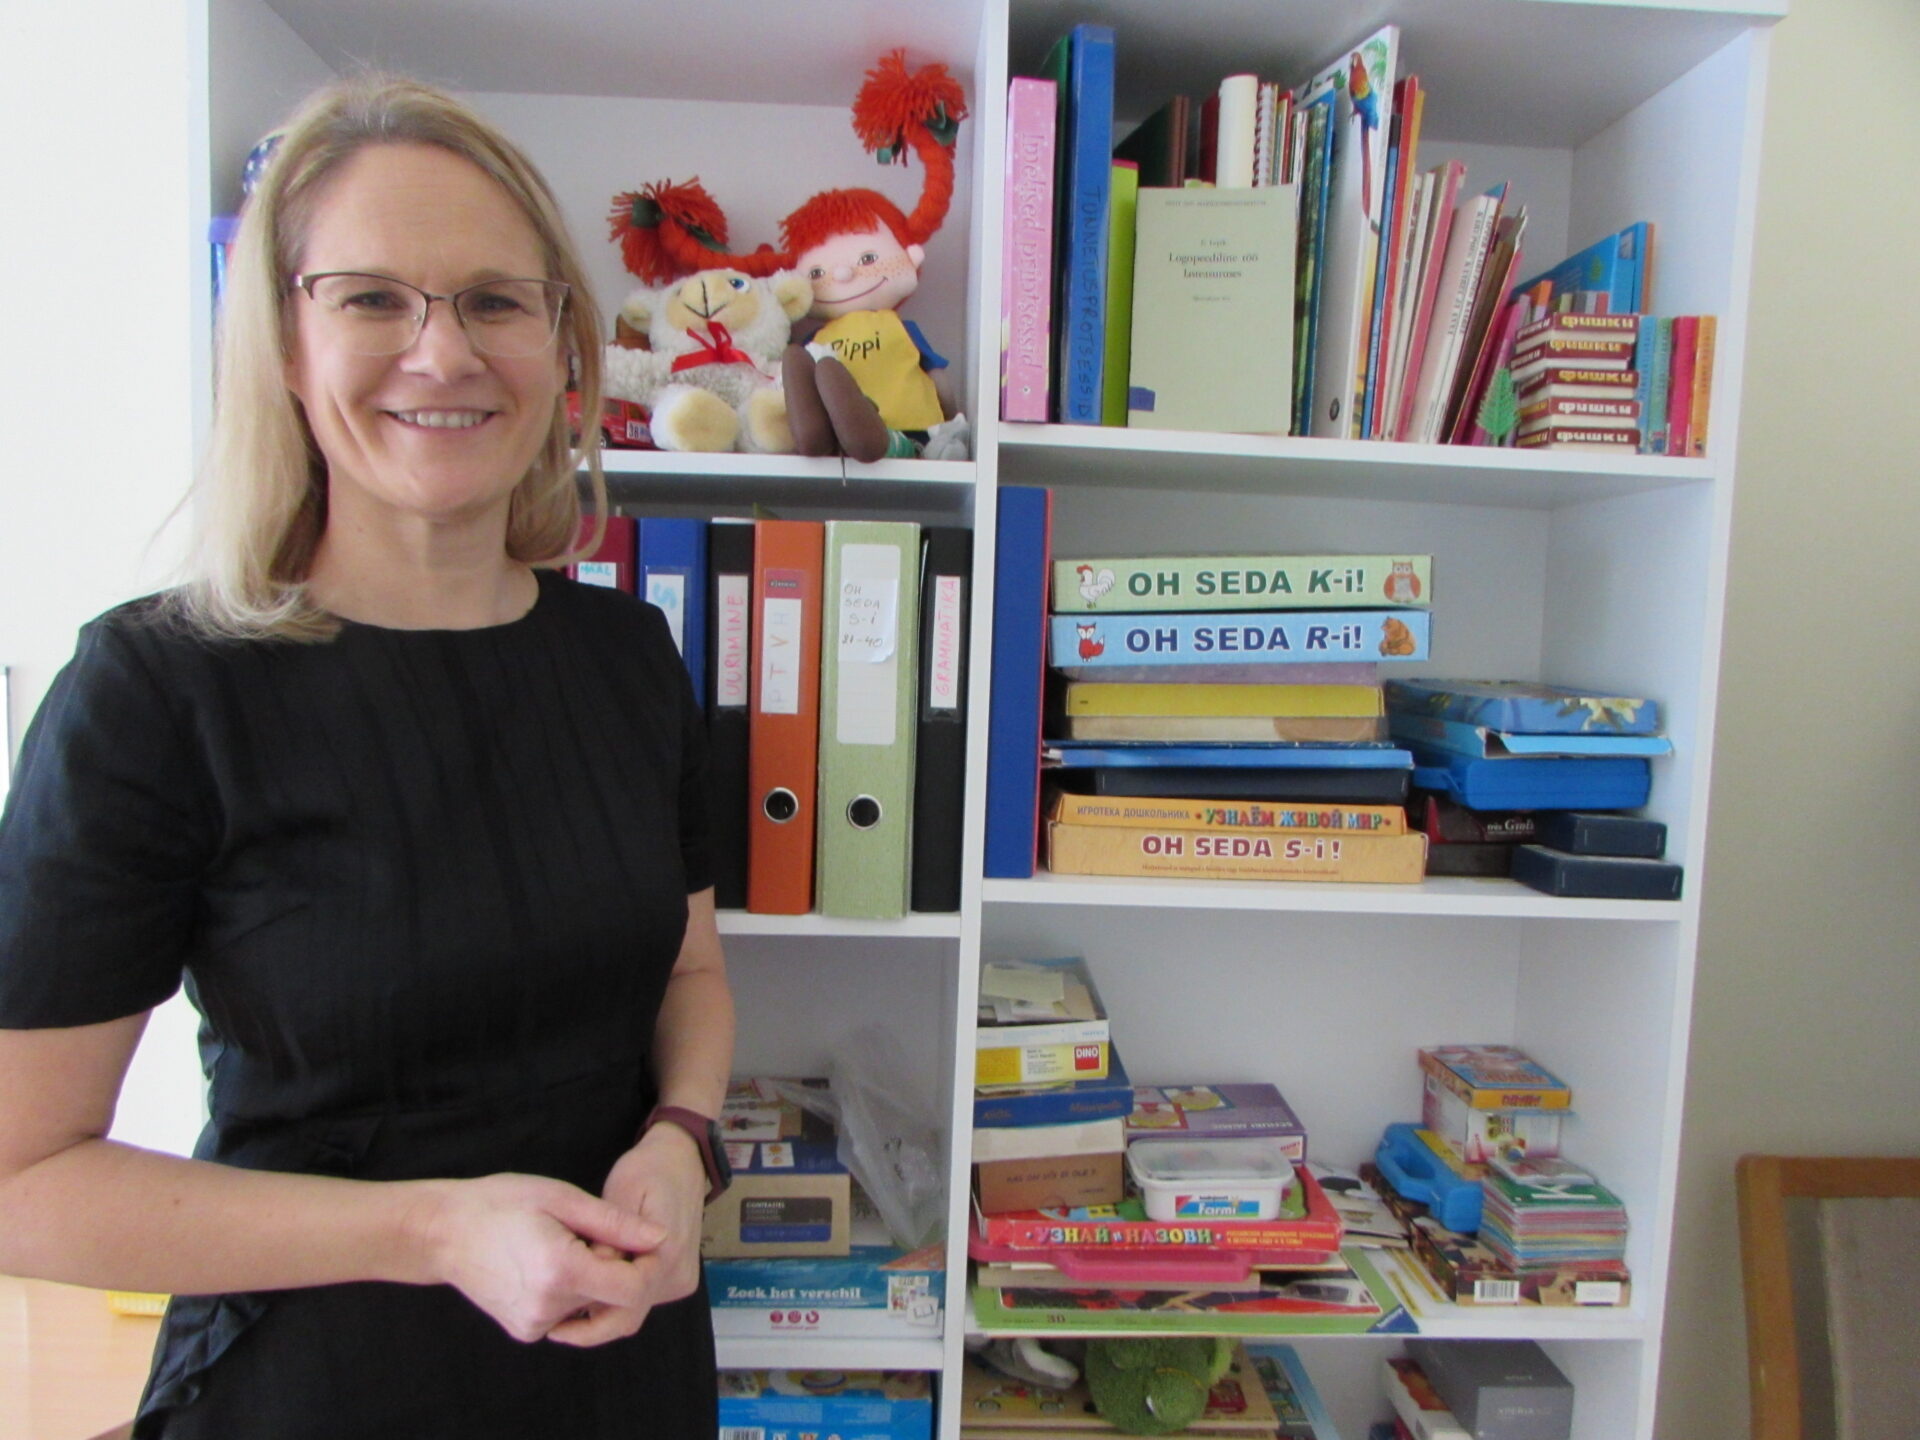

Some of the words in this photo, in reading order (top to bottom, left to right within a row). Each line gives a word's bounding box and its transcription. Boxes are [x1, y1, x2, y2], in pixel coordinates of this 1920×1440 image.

[1020, 133, 1046, 233] Imelised
[1015, 242, 1042, 369] printsessid
[831, 331, 880, 361] Pippi
[1127, 571, 1181, 597] OH
[1195, 570, 1293, 596] SEDA
[1307, 568, 1365, 594] K-i!
[724, 592, 743, 696] UURIMINE
[935, 580, 957, 697] GRAMMATIKA
[1126, 627, 1179, 653] OH
[1193, 626, 1291, 652] SEDA
[1305, 625, 1362, 650] R-i!
[1077, 806, 1120, 817] ИГРОТЕКА
[1123, 808, 1190, 820] ДОШКОЛЬНИКА
[1204, 806, 1275, 828] УЗНАЁМ
[1279, 808, 1342, 829] ЖИВОЙ
[1347, 811, 1383, 831] МИР
[1141, 835, 1184, 856] OH
[1195, 836, 1273, 859] SEDA
[1075, 1047, 1099, 1059] DINO
[1198, 1202, 1236, 1216] Farmi
[1035, 1224, 1110, 1244] УЗНАЙ
[1125, 1227, 1213, 1244] НАЗОВИ
[726, 1286, 767, 1299] Zoek
[770, 1286, 794, 1299] het
[800, 1286, 862, 1299] verschil
